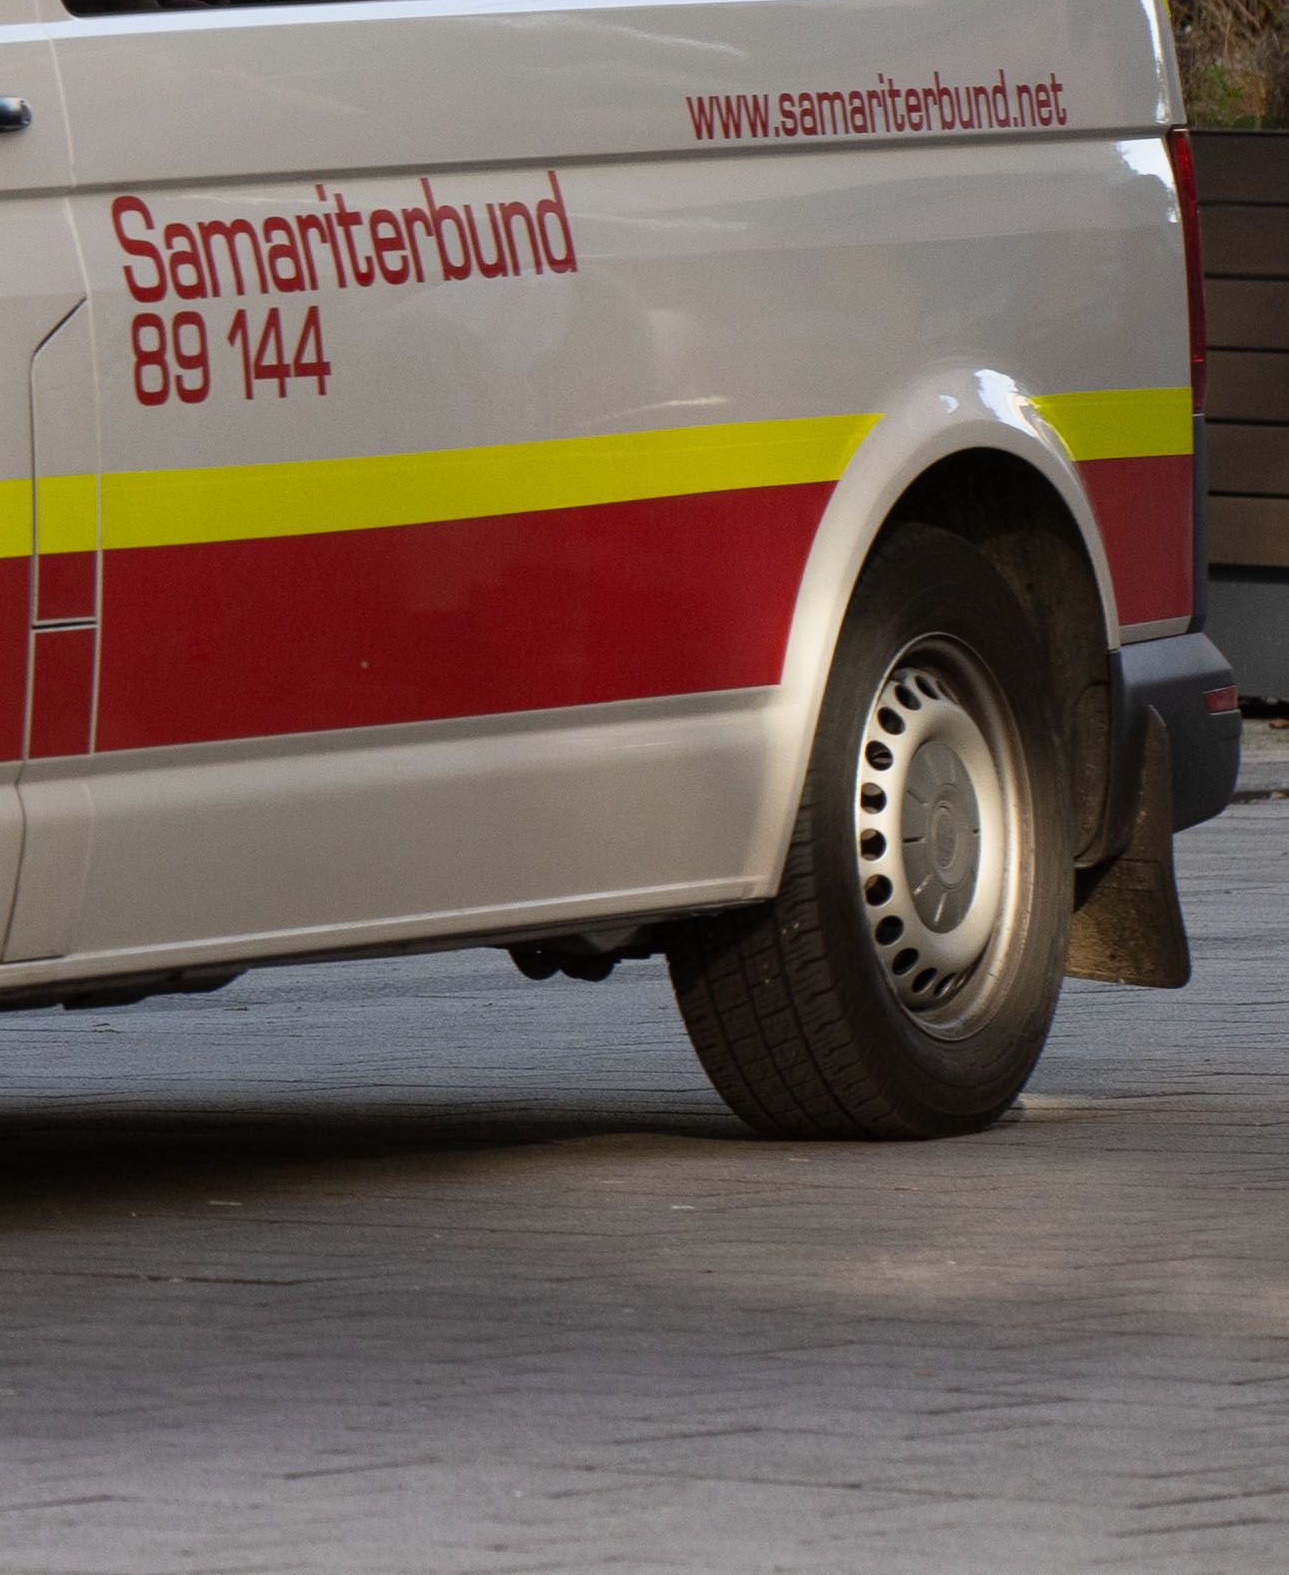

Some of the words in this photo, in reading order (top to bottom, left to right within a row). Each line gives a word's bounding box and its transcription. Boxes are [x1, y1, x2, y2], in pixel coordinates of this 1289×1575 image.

[686, 69, 1067, 140] www.samariterbund.net
[111, 171, 578, 304] Samariterbund
[131, 311, 211, 407] 89
[226, 306, 332, 401] 144
